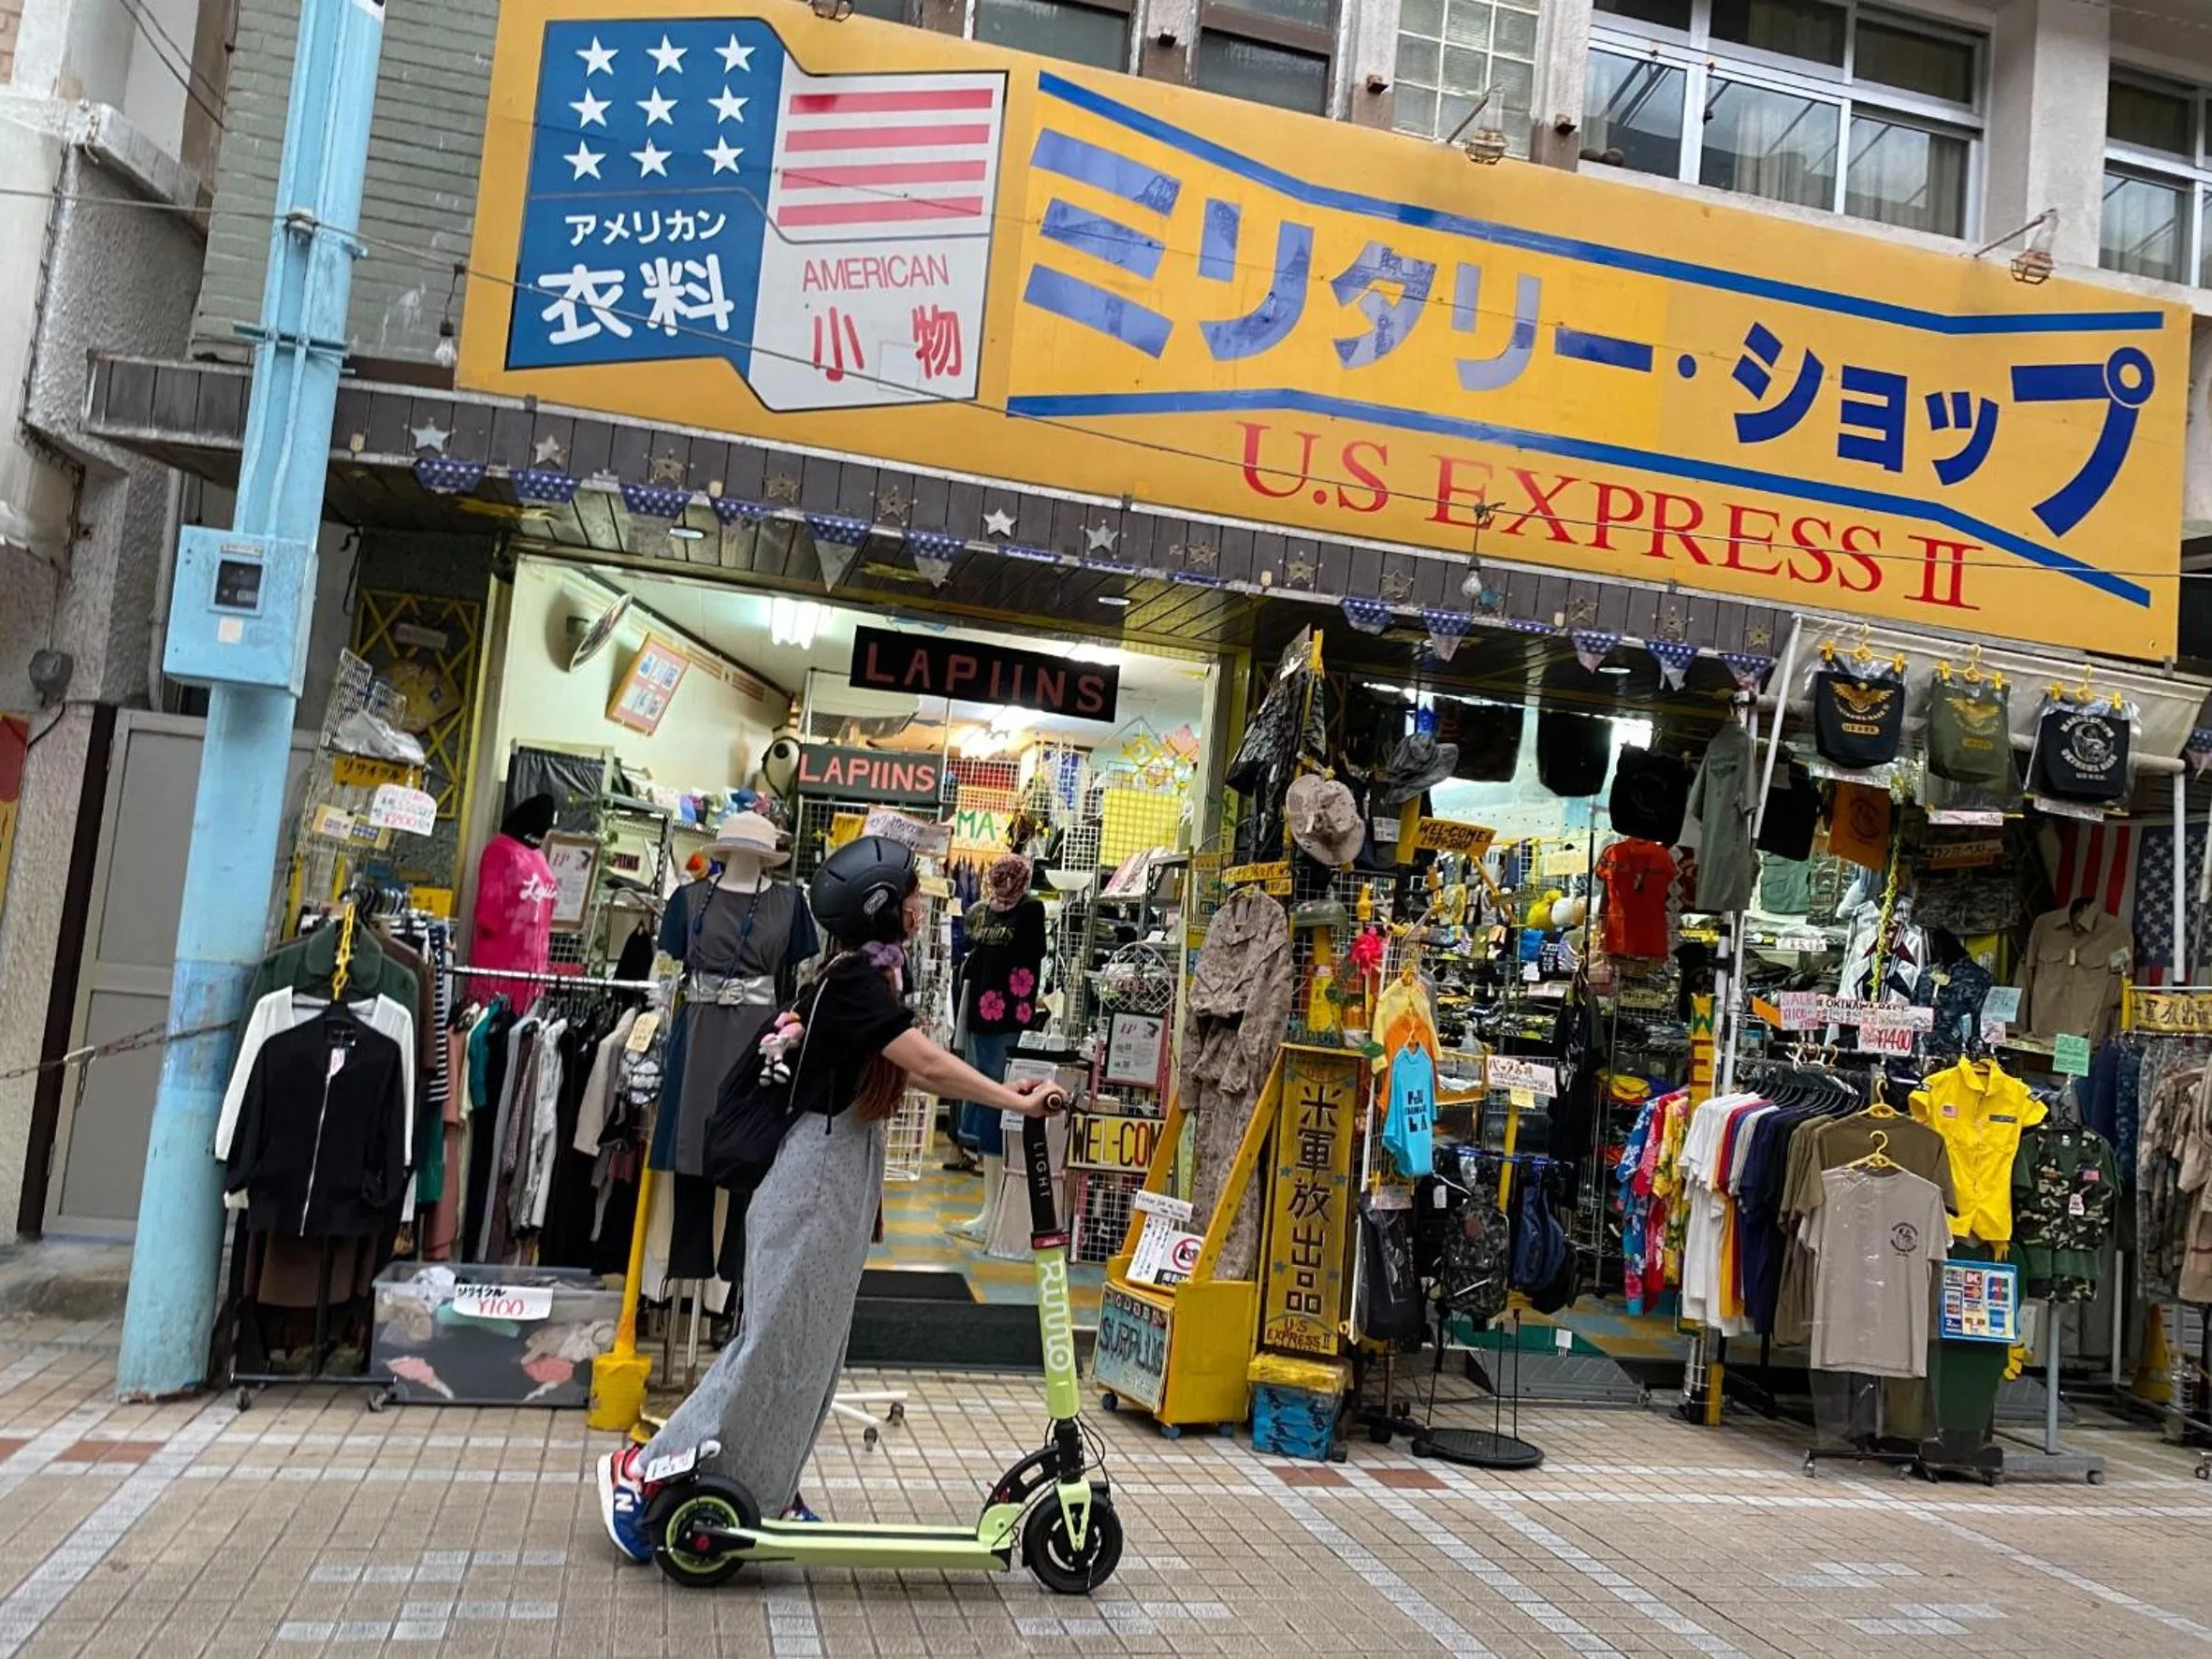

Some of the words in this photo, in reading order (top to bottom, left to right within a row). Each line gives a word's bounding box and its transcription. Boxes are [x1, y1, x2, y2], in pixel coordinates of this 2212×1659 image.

[565, 209, 726, 246] アメリカン
[537, 254, 734, 344] 衣料
[802, 254, 950, 292] AMERICAN
[812, 305, 962, 382] 小物
[1236, 421, 1389, 513] U.S
[1424, 454, 1883, 593] EXPRESS
[865, 641, 1106, 714] LAPIINS
[799, 752, 936, 793] LAPIINS
[1032, 1142, 1051, 1199] LIGHT
[1287, 1084, 1344, 1315] 米軍放出品
